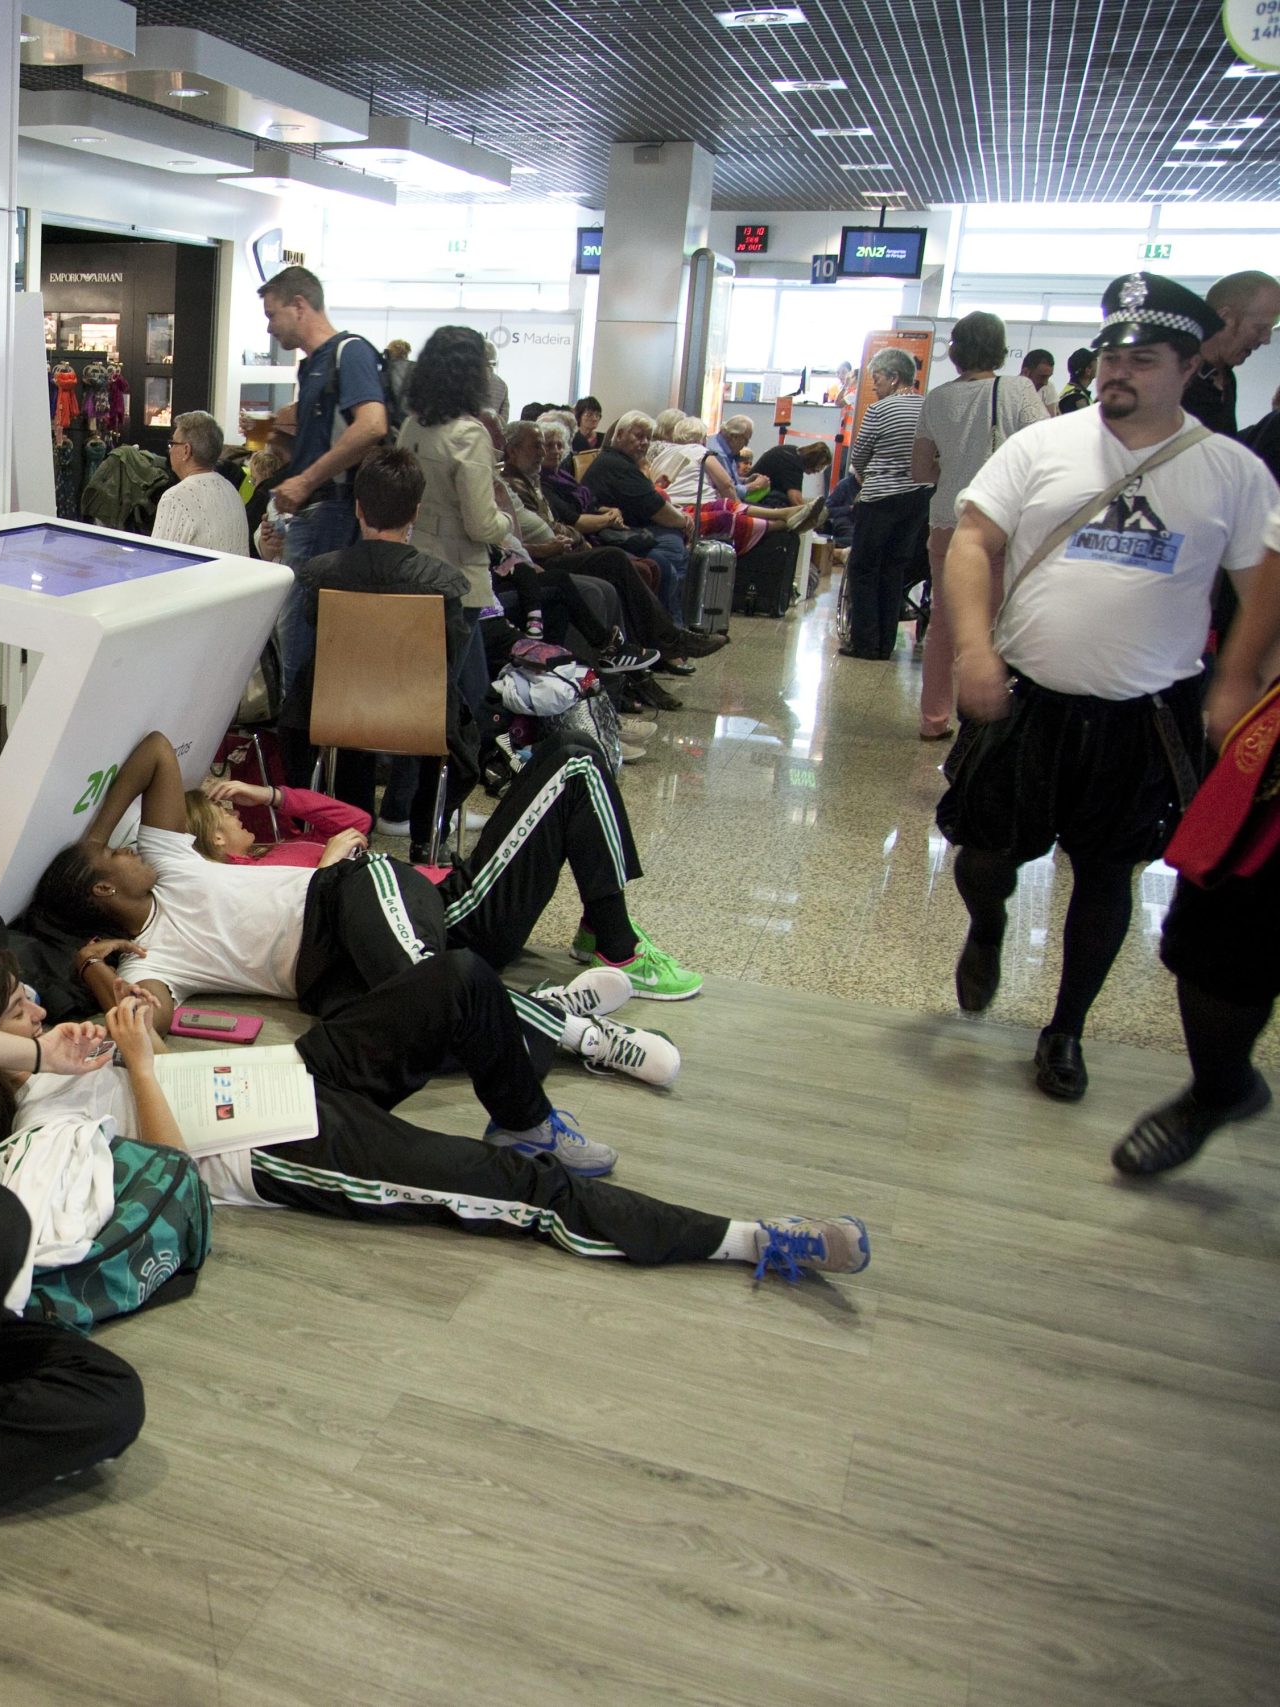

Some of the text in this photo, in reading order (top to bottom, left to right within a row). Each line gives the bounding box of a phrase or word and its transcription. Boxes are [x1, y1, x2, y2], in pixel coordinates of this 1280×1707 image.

[1256, 1, 1280, 15] 09
[813, 259, 835, 278] 10
[49, 272, 123, 283] EMPORIO ARMANI
[523, 331, 572, 346] Madeira
[384, 1187, 521, 1220] SPORTIVA
